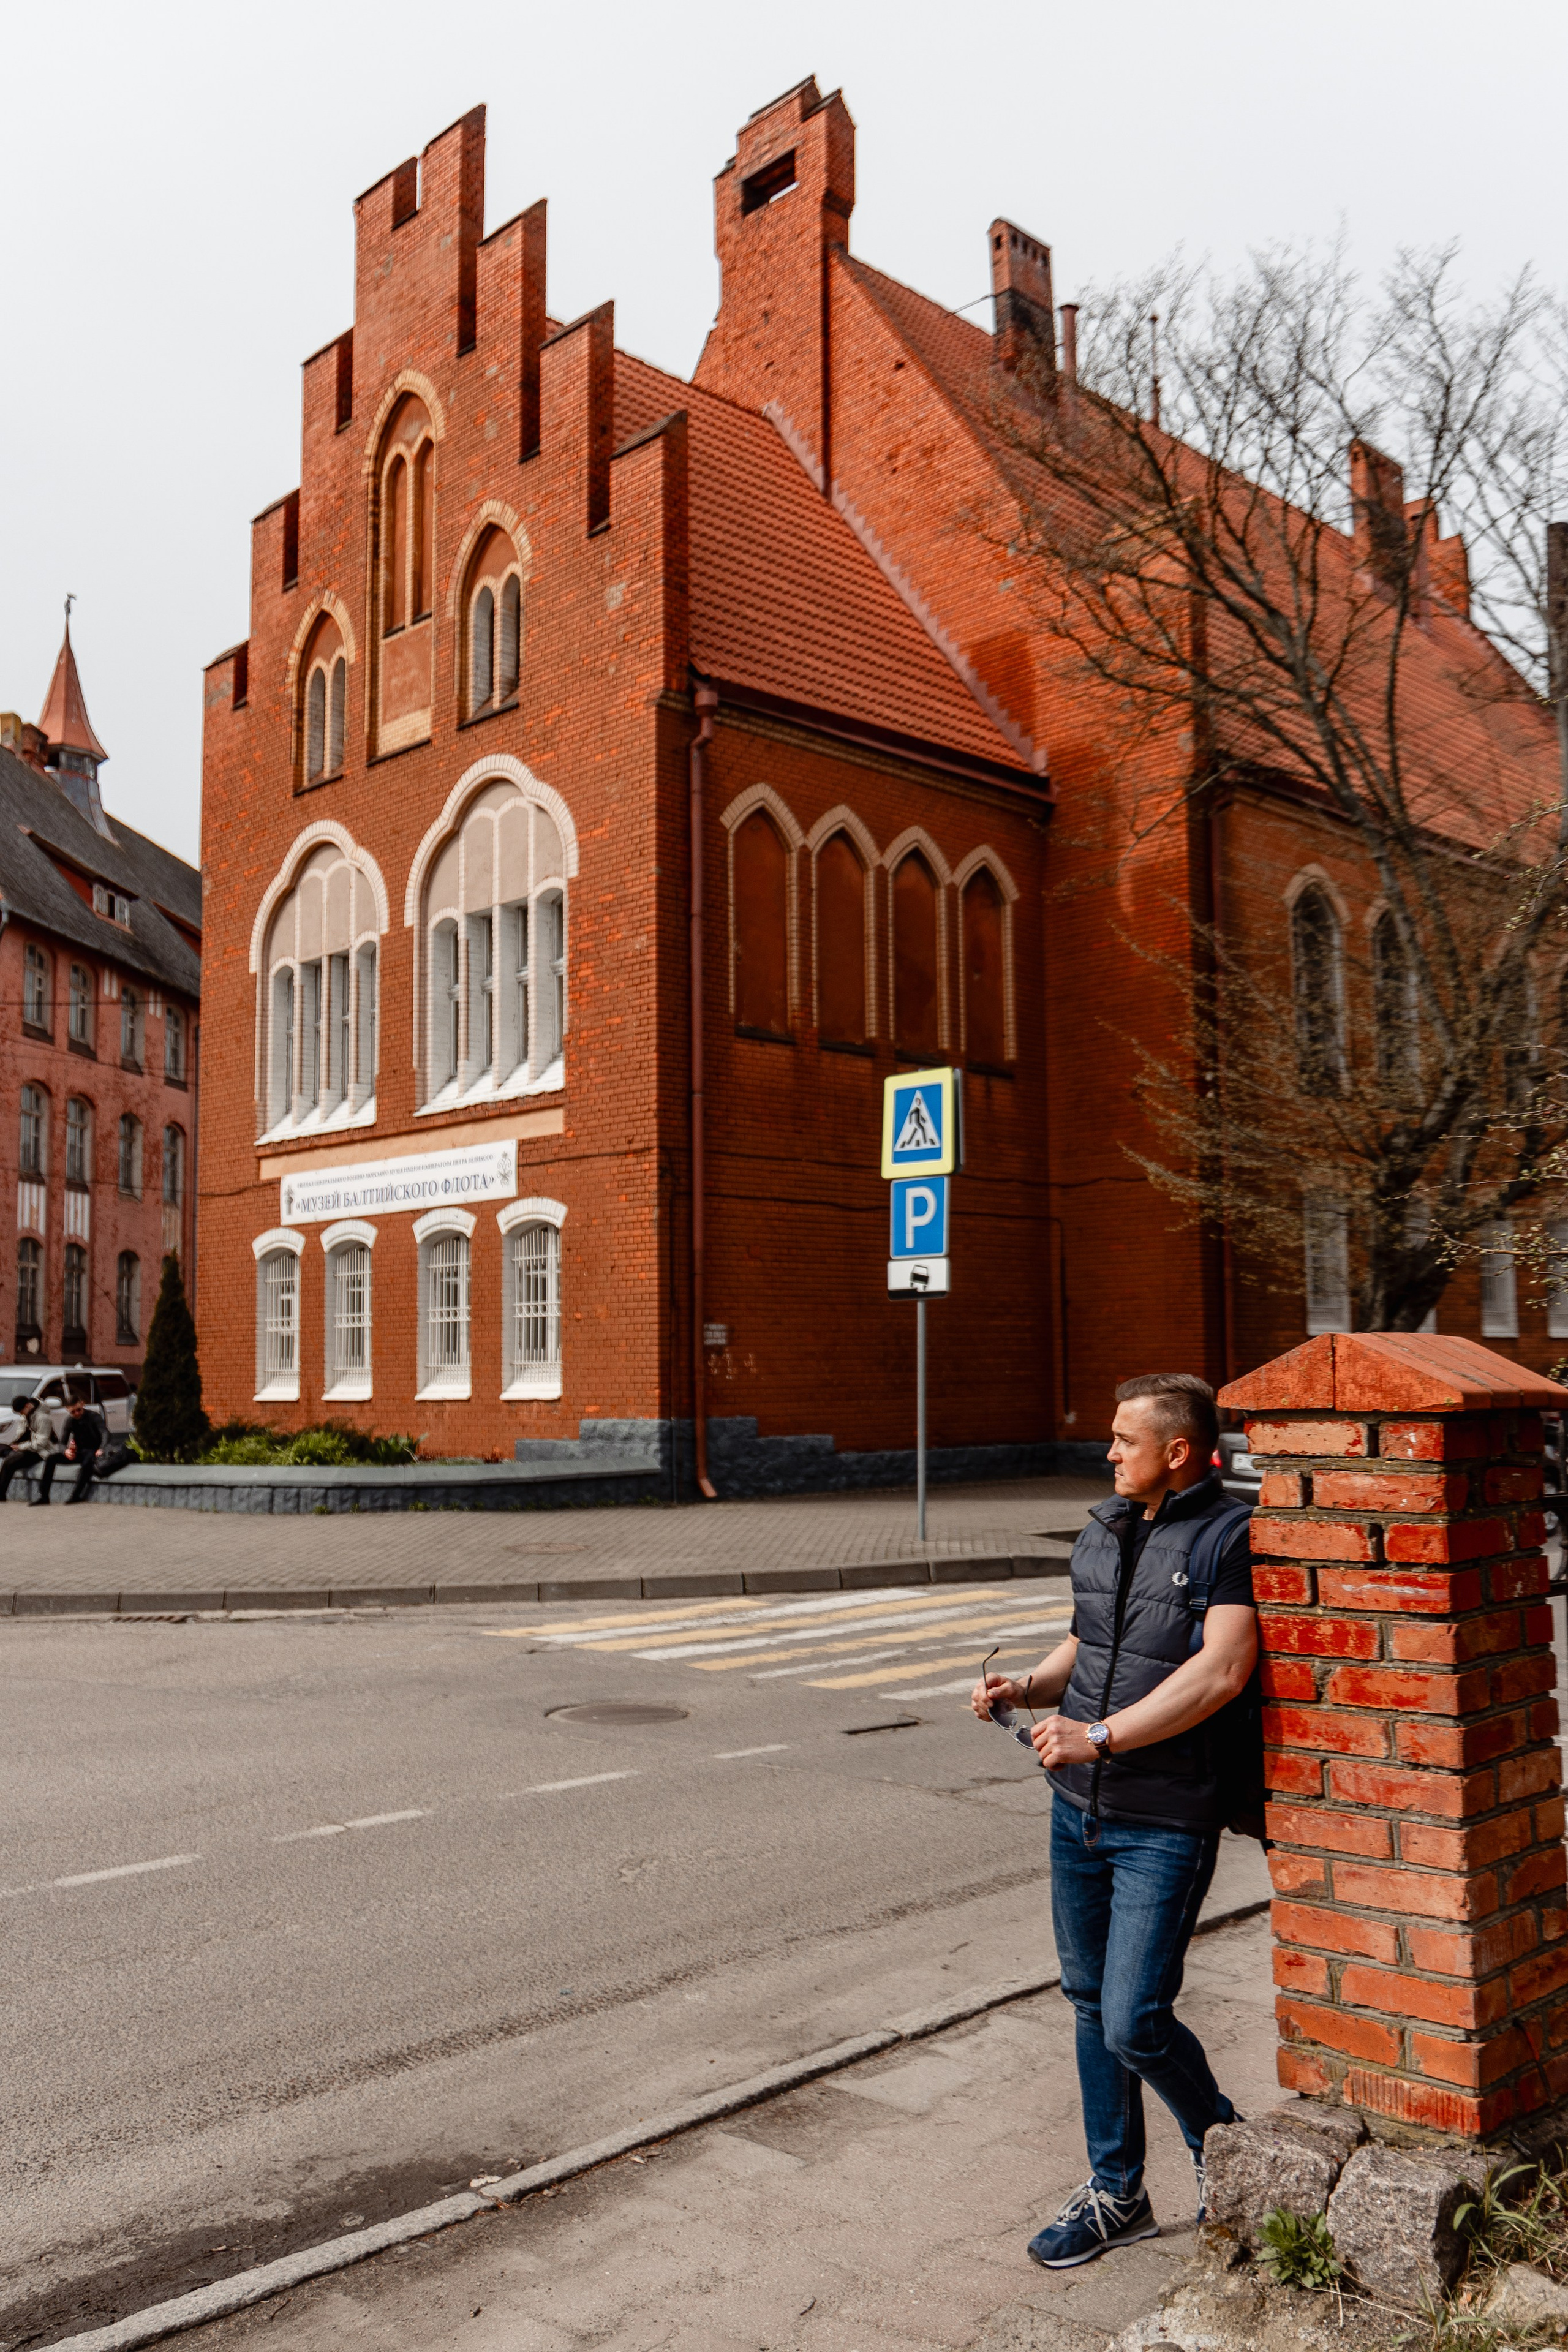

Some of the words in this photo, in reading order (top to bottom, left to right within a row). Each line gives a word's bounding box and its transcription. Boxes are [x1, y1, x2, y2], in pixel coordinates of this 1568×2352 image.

[422, 1160, 451, 1170] ИМПЕРАТОРА
[469, 1154, 494, 1163] ВЕЛИКОГО
[296, 1190, 341, 1213] «МУЗЕЙ
[344, 1180, 438, 1208] БАЛТИЙСКОГО
[441, 1173, 494, 1194] ФЛОТА»
[905, 1186, 938, 1250] P
